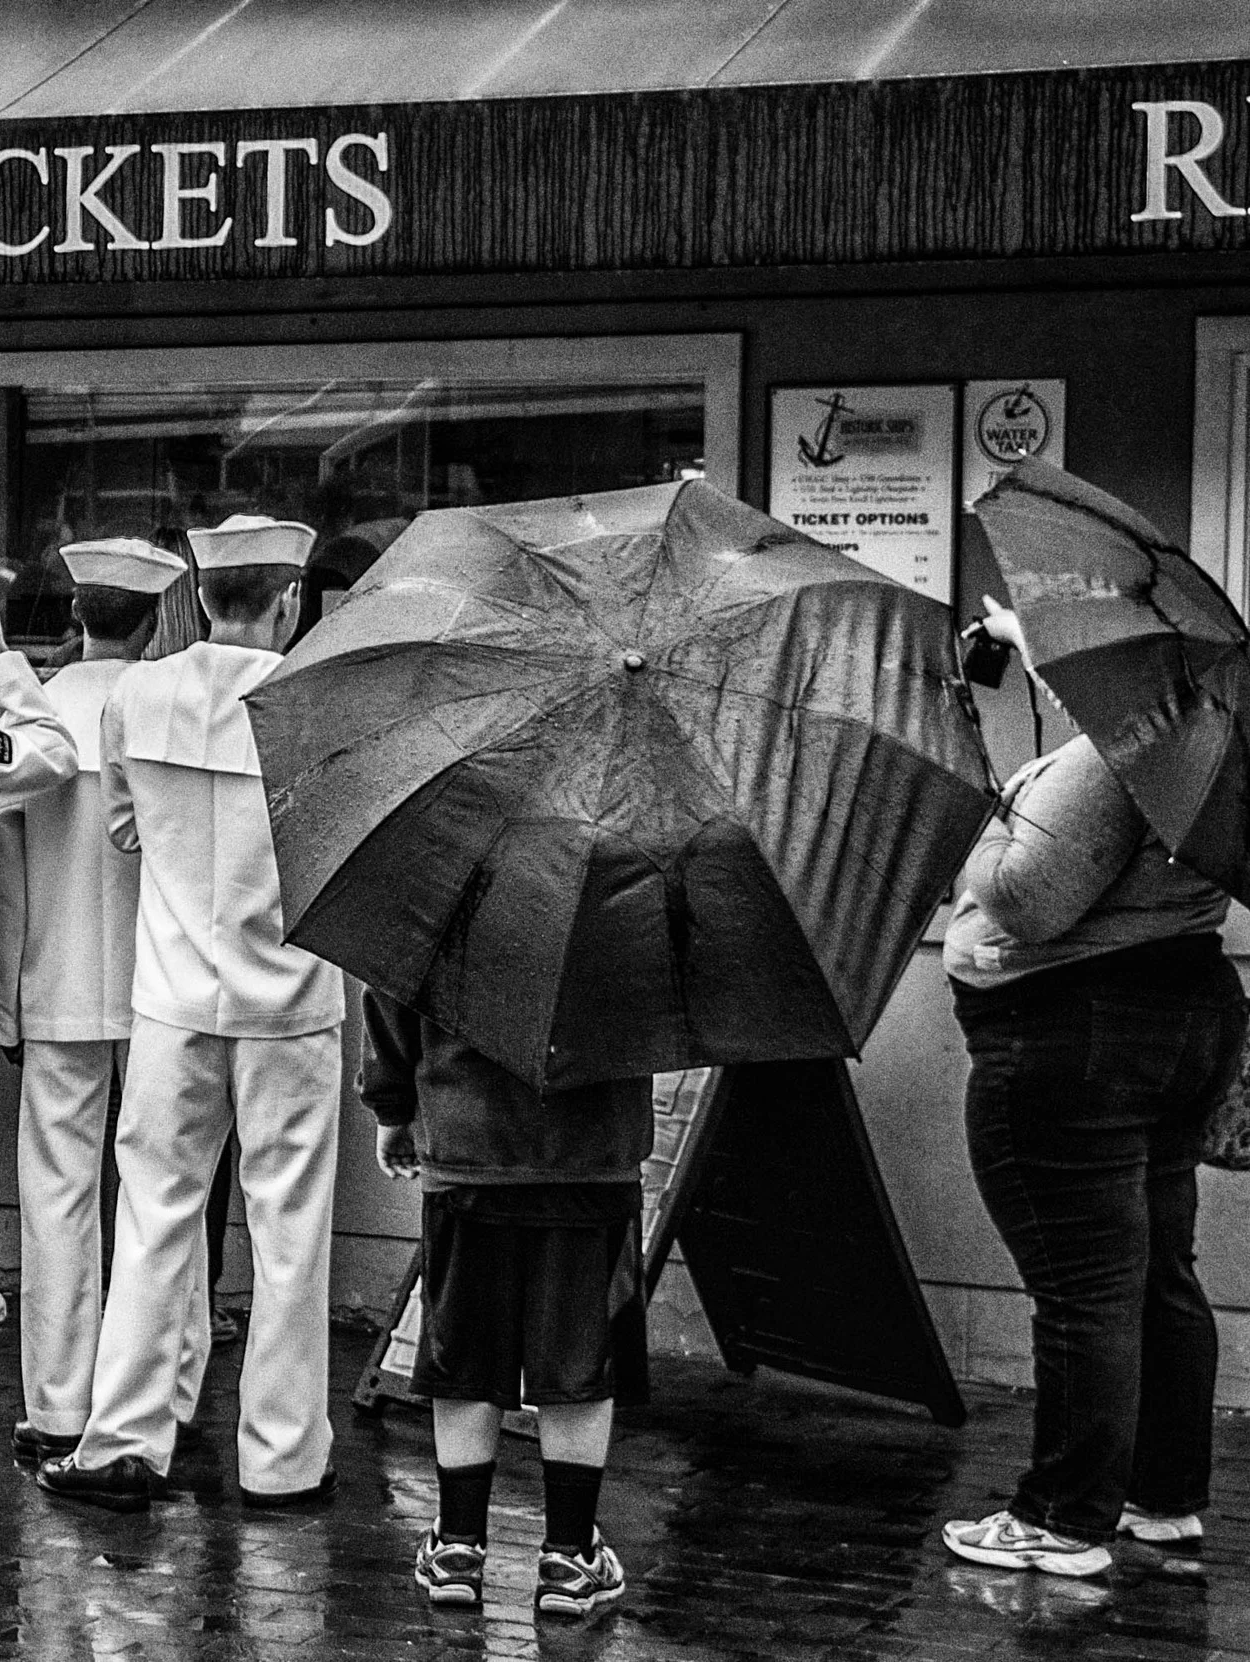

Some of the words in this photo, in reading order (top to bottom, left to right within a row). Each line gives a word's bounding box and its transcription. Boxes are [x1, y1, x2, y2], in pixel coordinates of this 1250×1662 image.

[1130, 98, 1250, 222] R
[986, 429, 1038, 441] WATER
[996, 440, 1030, 453] TAXI
[792, 512, 850, 526] TICKET
[855, 512, 929, 526] OPTIONS
